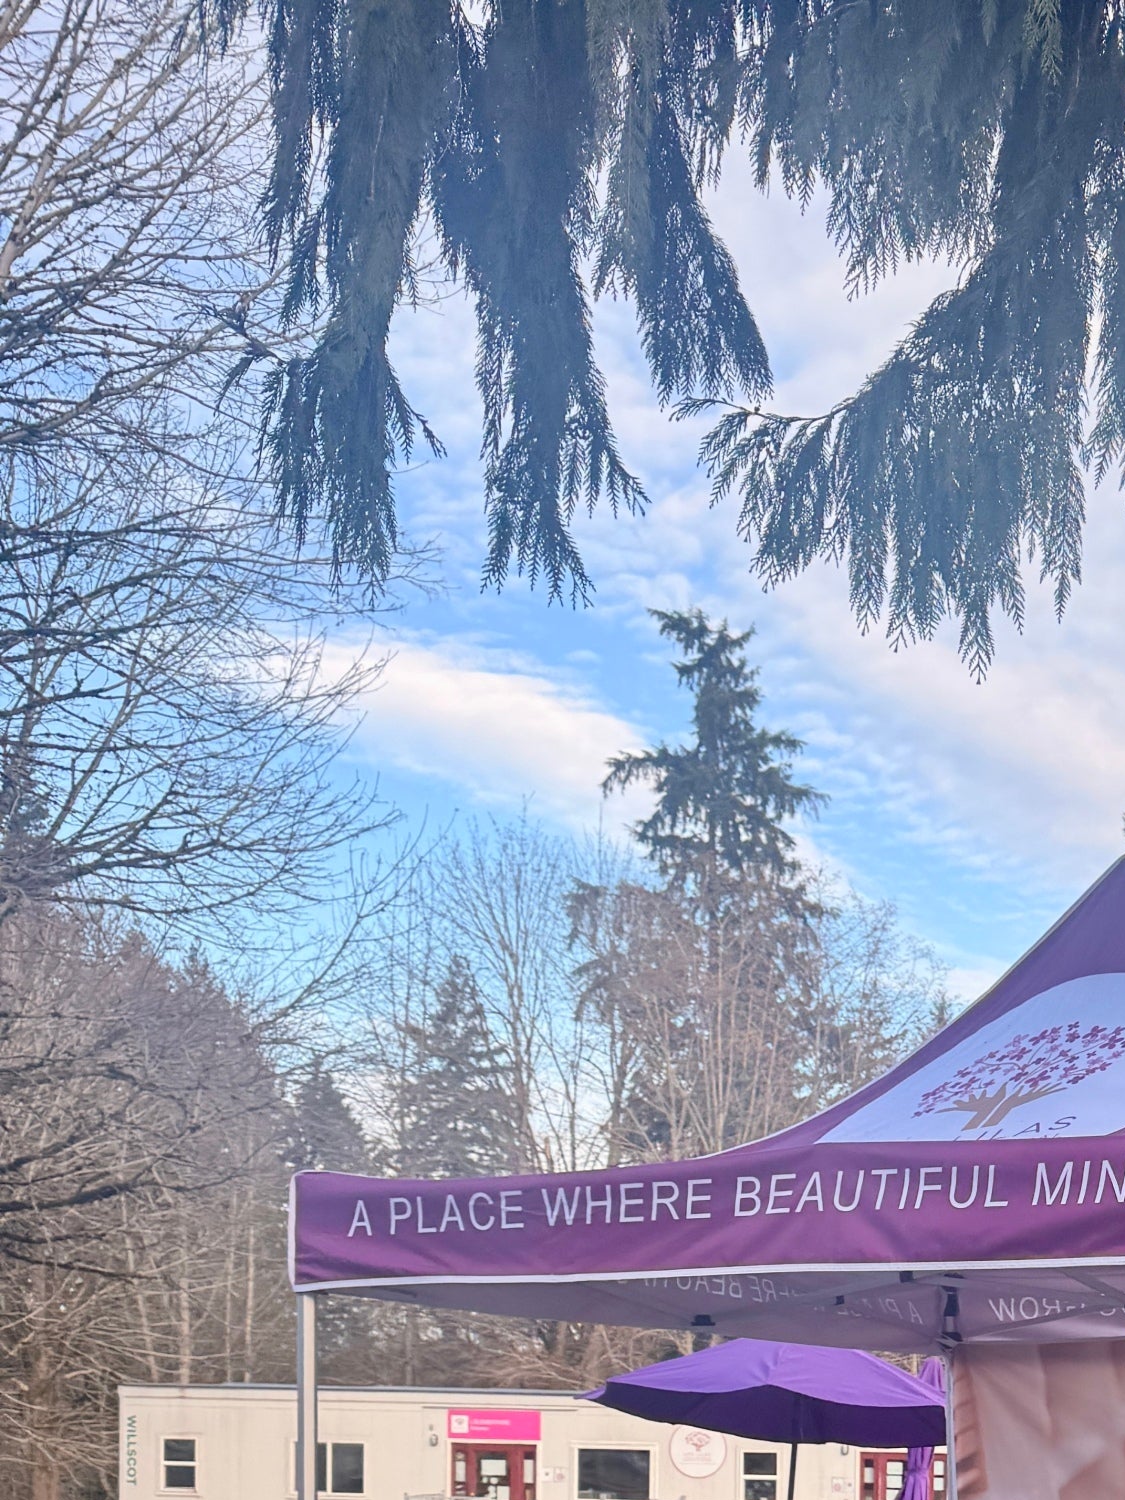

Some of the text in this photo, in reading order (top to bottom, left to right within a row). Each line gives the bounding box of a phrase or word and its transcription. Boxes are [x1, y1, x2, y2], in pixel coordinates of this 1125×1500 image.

[348, 1200, 373, 1238] A
[390, 1190, 525, 1236] PLACE
[541, 1178, 712, 1227] WHERE
[733, 1164, 1009, 1219] BEAUTIFUL
[127, 1415, 137, 1486] WILLSCOT
